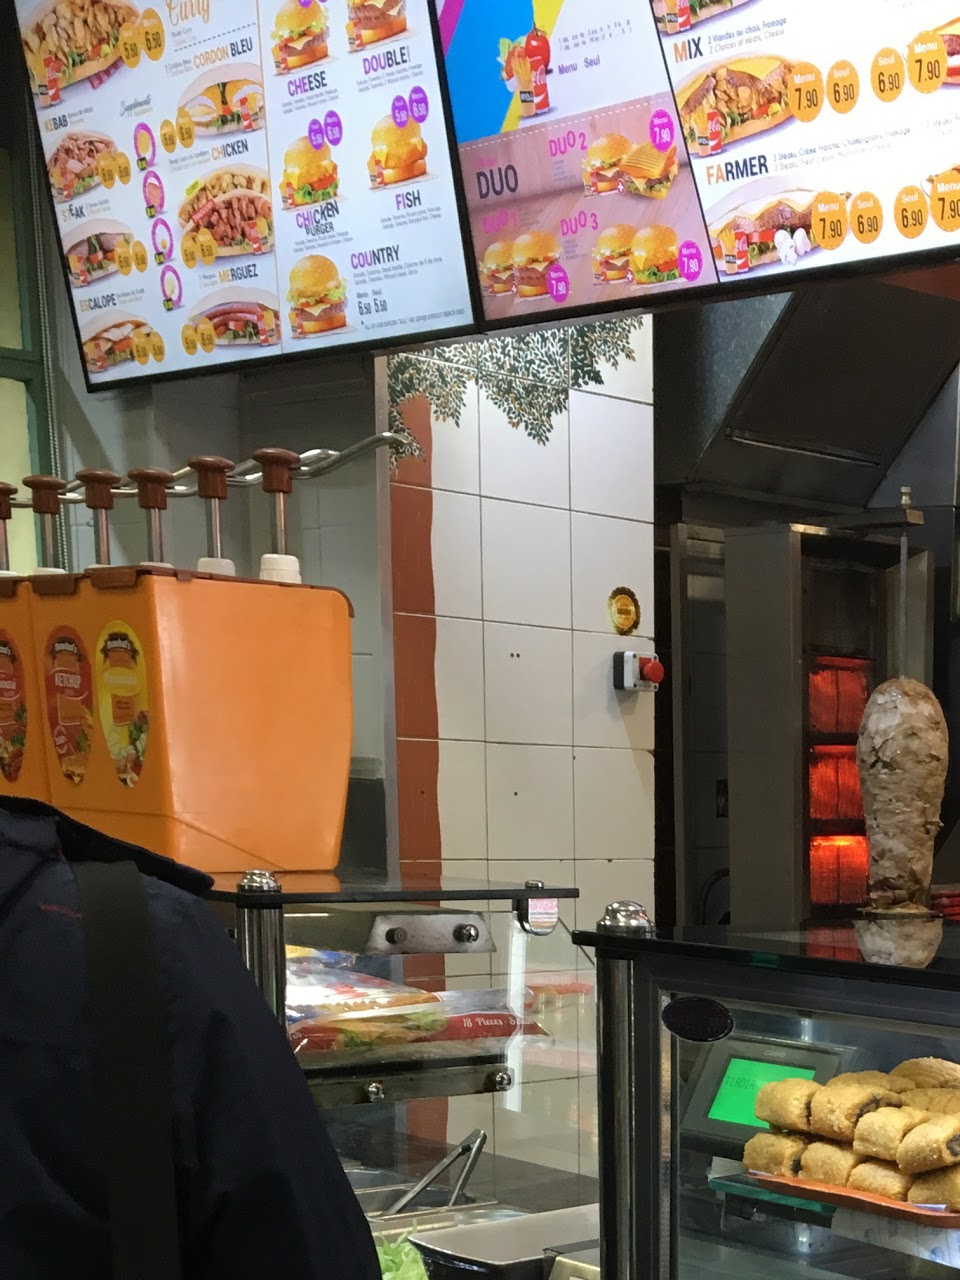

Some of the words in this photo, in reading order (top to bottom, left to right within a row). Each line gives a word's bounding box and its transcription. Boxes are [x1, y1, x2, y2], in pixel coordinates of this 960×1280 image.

[762, 17, 787, 30] Fromage
[144, 31, 162, 51] 6.50
[673, 36, 704, 63] MIX
[913, 41, 938, 54] Menu
[193, 44, 230, 69] CORDON
[230, 37, 253, 57] BLEU
[362, 46, 408, 75] DOUBLE
[877, 54, 896, 66] Seul
[558, 62, 578, 76] Menu
[584, 54, 601, 69] Seul
[833, 67, 850, 79] Seul
[914, 58, 941, 84] 7.90
[287, 70, 328, 97] CHEESE
[793, 72, 816, 85] Menu
[877, 71, 901, 94] 6.90
[794, 87, 819, 112] 7.90
[833, 82, 855, 104] 6.90
[412, 102, 427, 118] 6.50
[43, 114, 69, 132] KEBAB
[327, 126, 340, 141] 6.50
[549, 129, 577, 158] DUO
[578, 132, 588, 151] 2
[653, 127, 671, 144] 7.90
[211, 138, 249, 160] CHICKEN
[706, 154, 769, 185] FARMER
[476, 164, 519, 200] DUO
[936, 181, 960, 194] Menu
[395, 189, 422, 211] FISH
[817, 201, 840, 214] Menu
[856, 199, 874, 210] Seul
[900, 192, 919, 204] Seul
[62, 204, 86, 222] STEAK
[295, 200, 340, 229] CHICKEN
[901, 207, 923, 229] 6.90
[304, 222, 335, 237] BURGER
[560, 210, 587, 237] DUO
[590, 212, 599, 231] 3
[818, 217, 842, 241] 7.90
[856, 214, 879, 235] 6.90
[350, 244, 400, 270] COUNTRY
[682, 257, 699, 274] 7.90
[218, 263, 258, 283] MERGUEZ
[551, 280, 567, 296] 7.90
[80, 293, 117, 312] ESCALOPE
[358, 300, 372, 317] 6.50
[374, 298, 388, 313] 5.50
[54, 671, 82, 689] KETCHUP
[462, 1017, 473, 1028] 18
